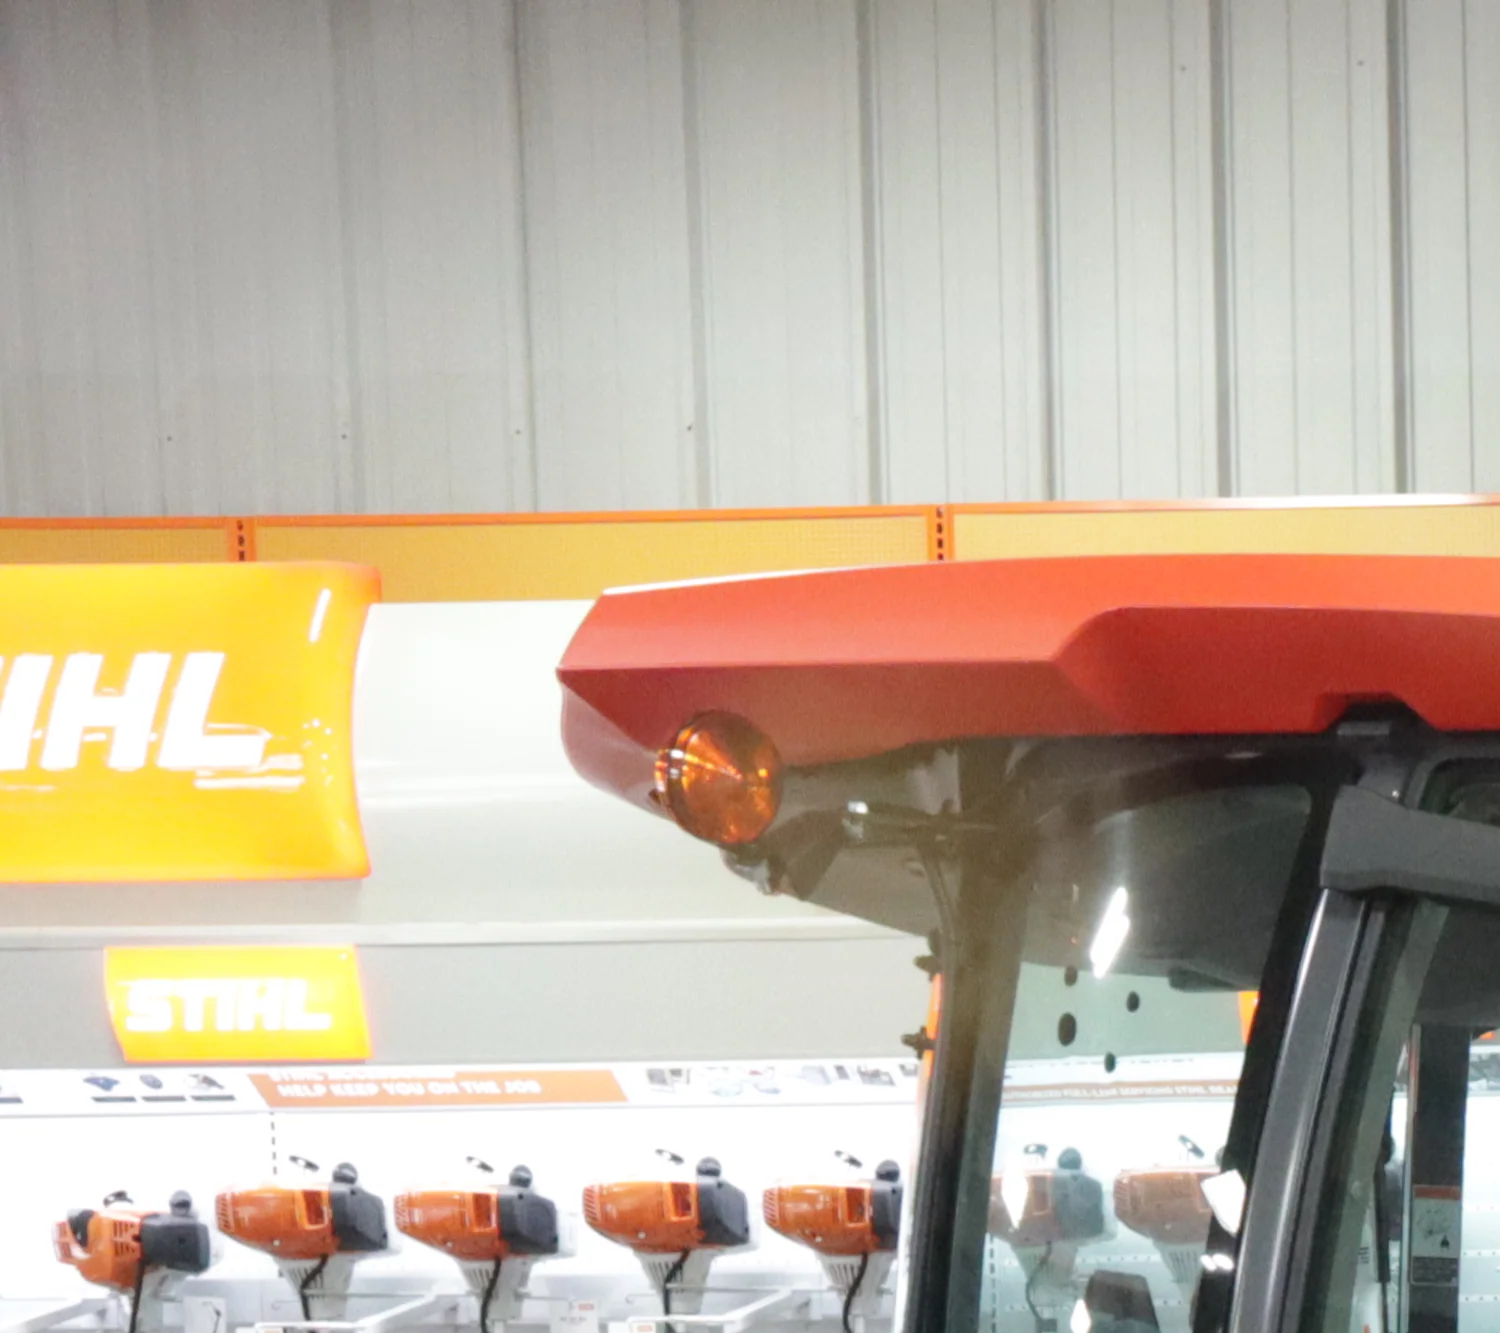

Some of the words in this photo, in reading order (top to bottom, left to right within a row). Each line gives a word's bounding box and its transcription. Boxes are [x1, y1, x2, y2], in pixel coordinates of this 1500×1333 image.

[0, 652, 266, 771] IHL
[126, 978, 331, 1032] STIHL
[276, 1082, 327, 1097] HELP
[329, 1082, 380, 1097] KEEP
[381, 1081, 426, 1095] YOU
[460, 1080, 501, 1094] THE
[504, 1079, 542, 1094] JOB
